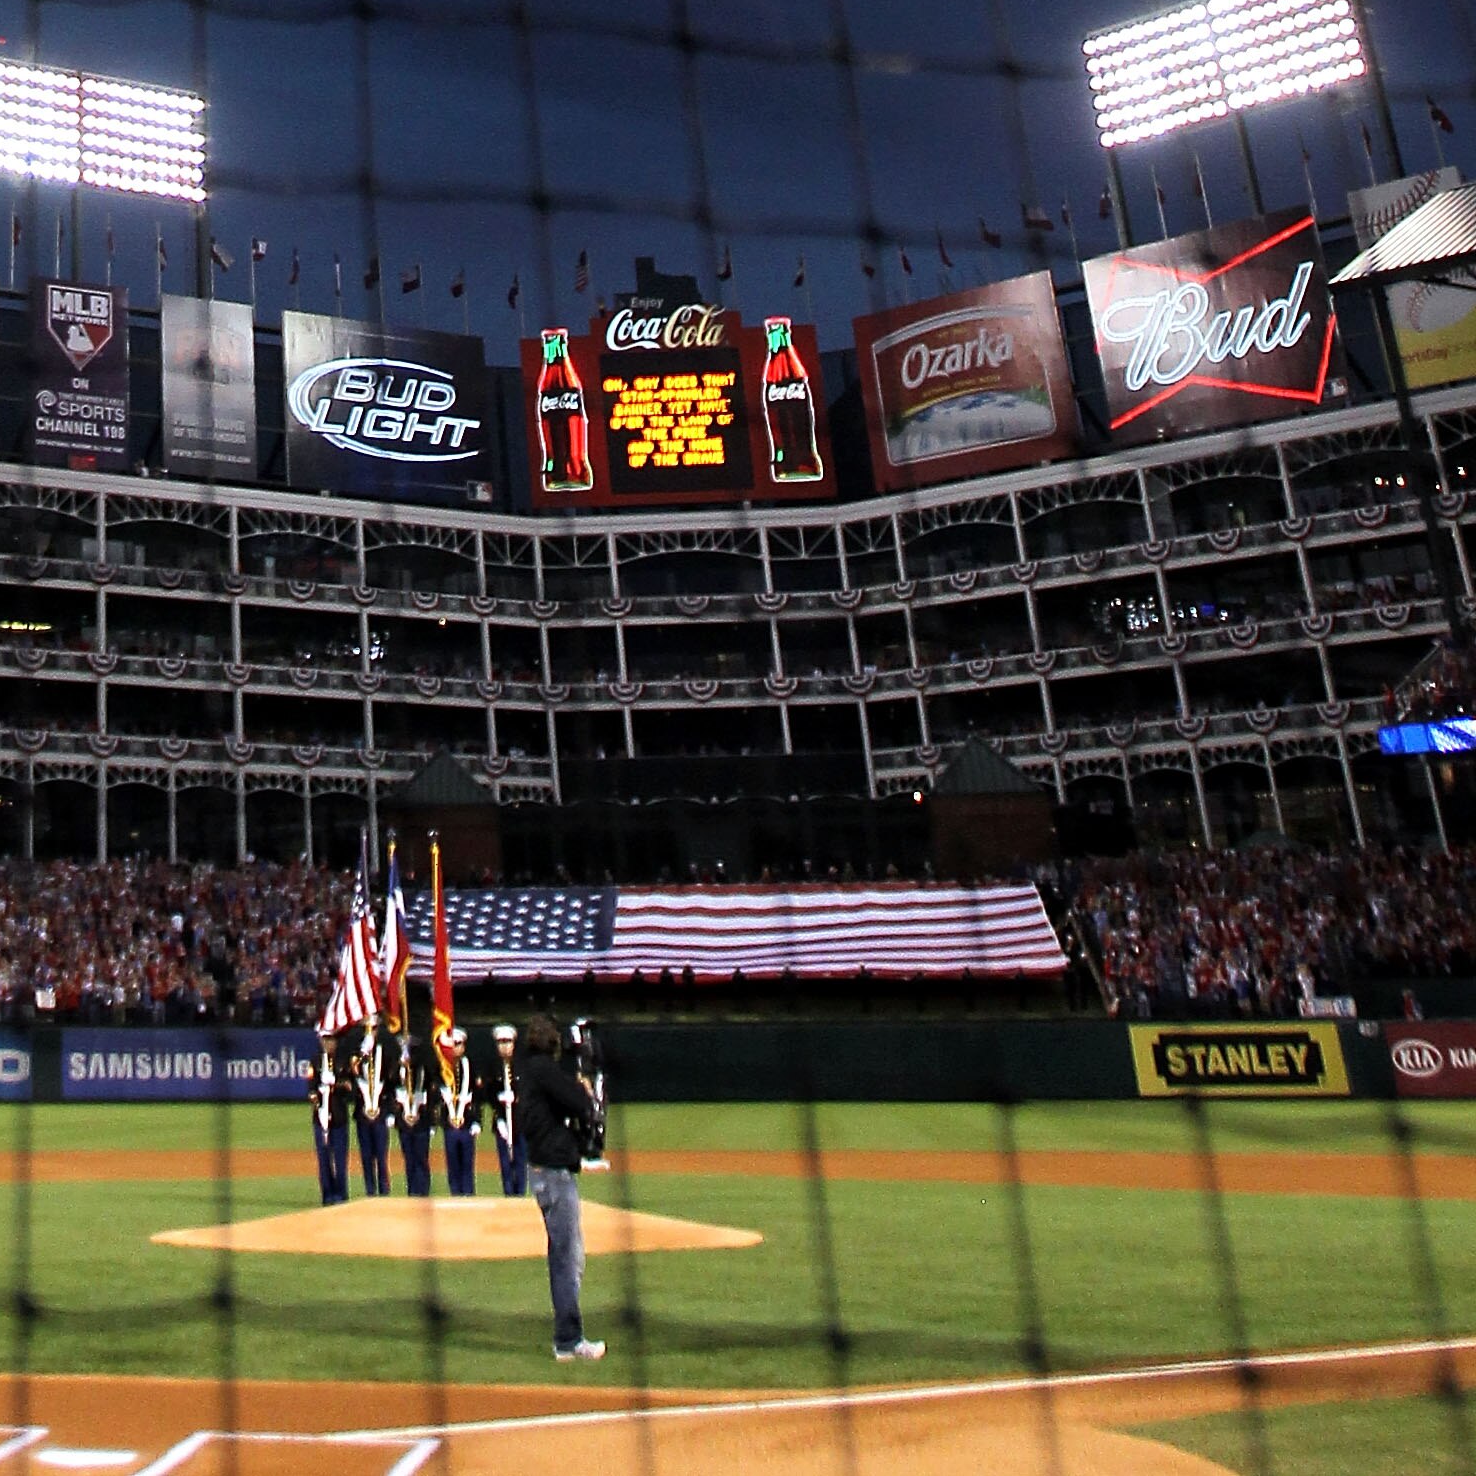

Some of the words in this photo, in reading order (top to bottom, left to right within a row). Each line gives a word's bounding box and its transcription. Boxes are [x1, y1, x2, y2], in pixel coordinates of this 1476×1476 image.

[52, 290, 109, 319] MLB
[630, 296, 665, 311] Enjoy
[605, 304, 727, 351] Coca-Cola
[1101, 261, 1314, 391] Bud
[901, 327, 1015, 389] Ozarka
[71, 377, 90, 391] ON
[334, 368, 456, 412] BUD
[58, 401, 126, 423] SPORTS
[613, 401, 663, 417] BANNER
[667, 400, 693, 415] YET
[35, 416, 101, 437] CHANNEL
[312, 398, 480, 448] LIGHT
[649, 415, 675, 428] THE
[677, 413, 714, 427] LAND
[716, 413, 734, 426] OF
[642, 427, 669, 441] THE
[627, 440, 655, 454] AND
[659, 439, 685, 453] THE
[688, 436, 723, 452] HOME
[628, 454, 648, 468] OF
[652, 453, 679, 467] THE
[682, 450, 725, 466] BRAVE
[68, 1050, 214, 1081] SAMSUNG
[1165, 1043, 1310, 1076] STANLEY
[1399, 1048, 1437, 1069] KIA
